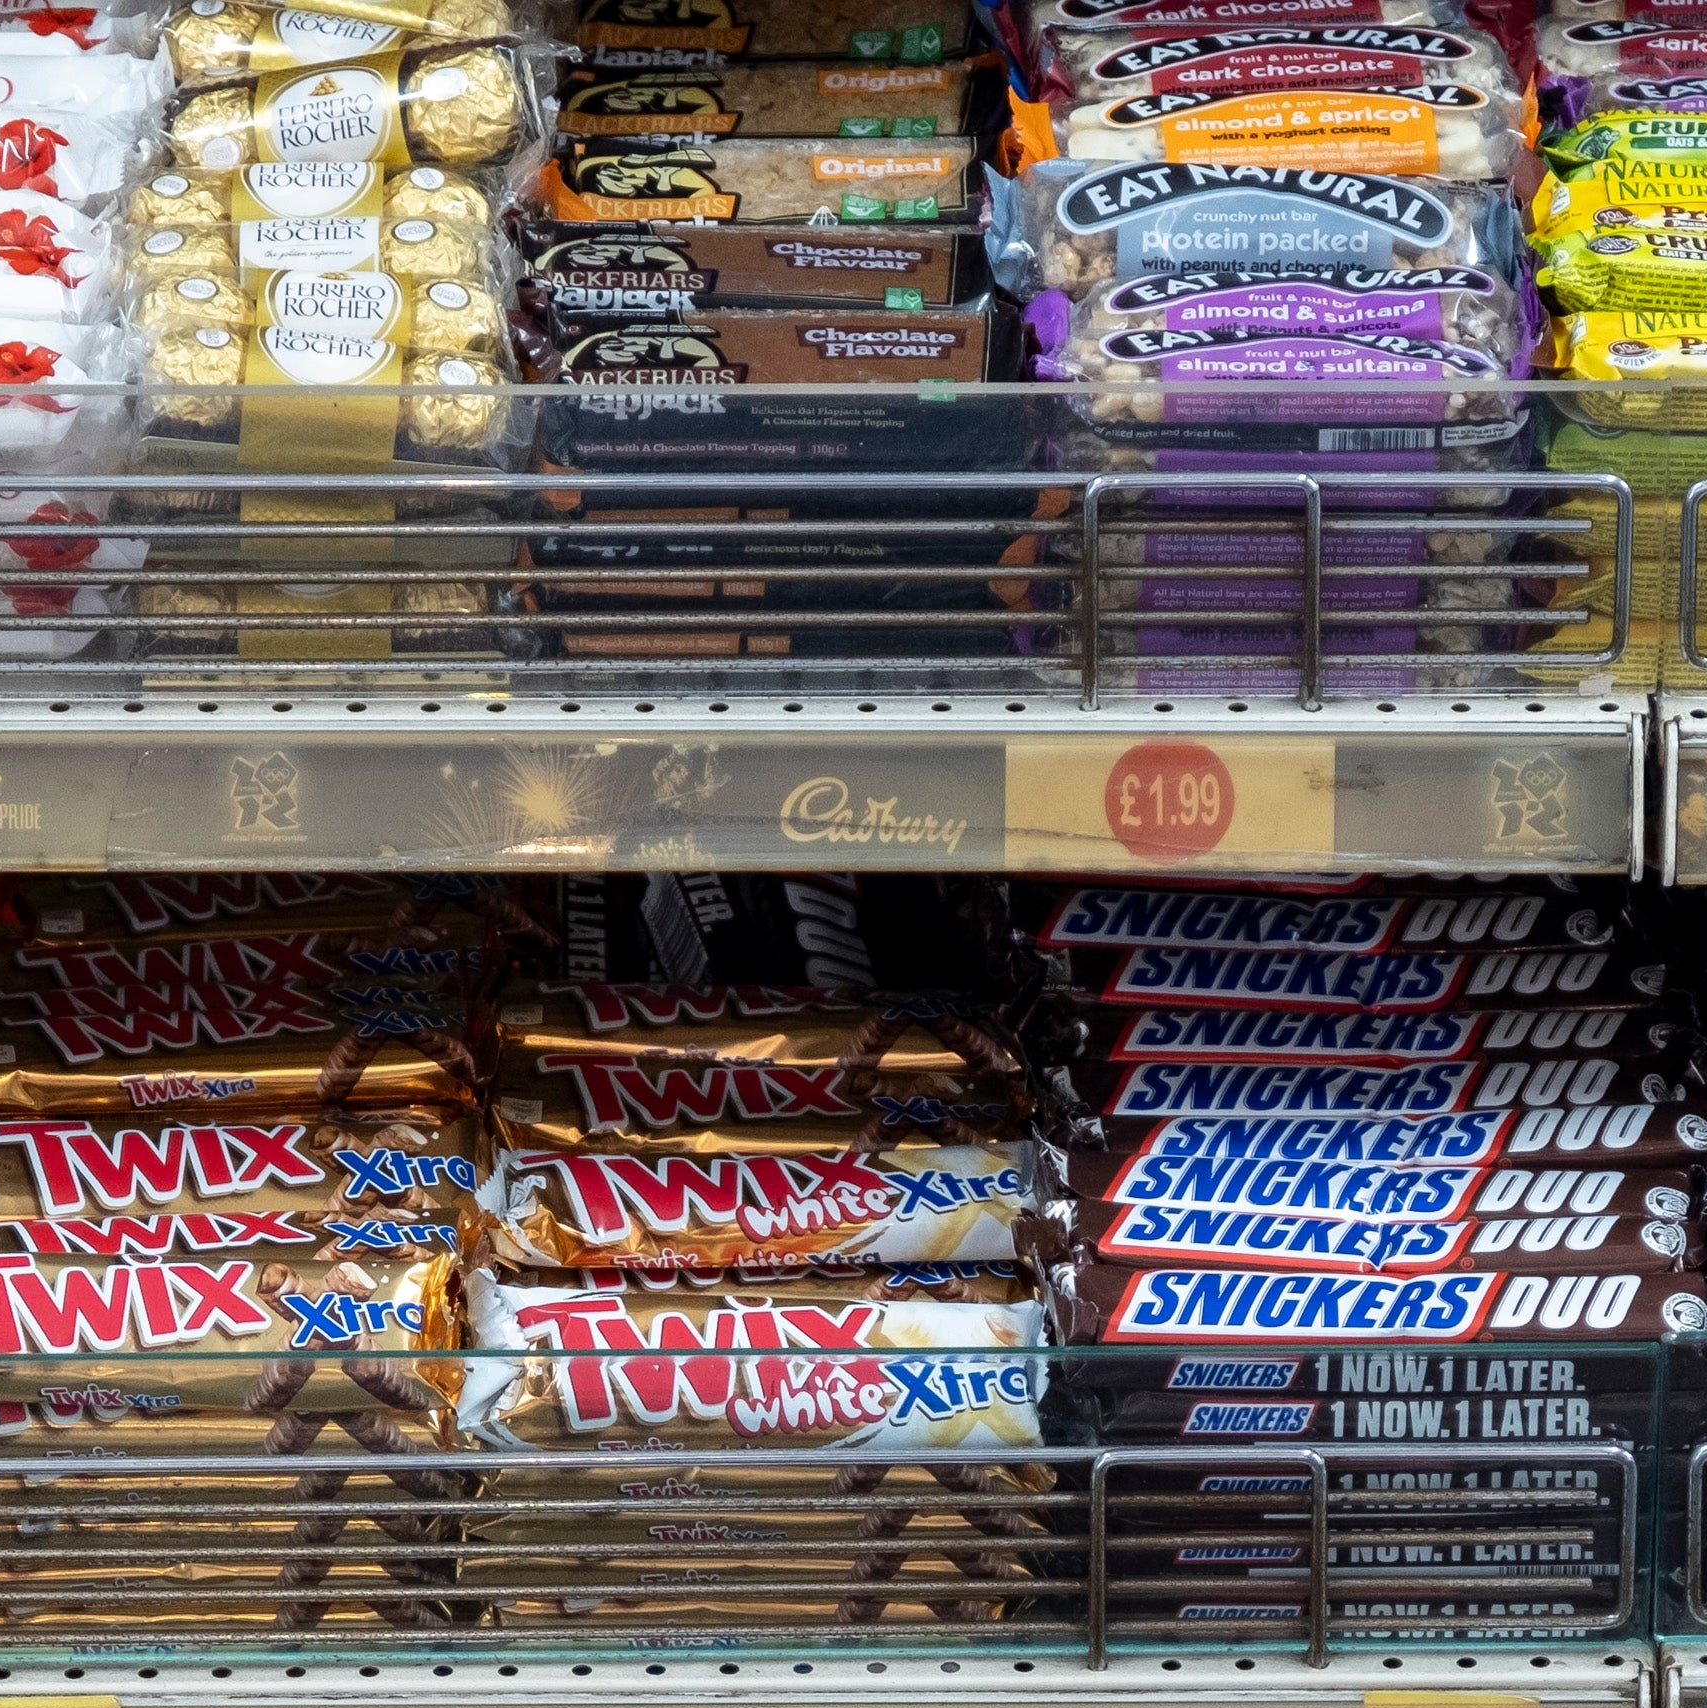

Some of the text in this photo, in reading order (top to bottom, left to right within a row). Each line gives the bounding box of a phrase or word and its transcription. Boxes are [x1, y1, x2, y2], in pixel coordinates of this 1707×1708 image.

[1178, 56, 1394, 82] dark chocolate
[1175, 105, 1421, 133] almond & apricot
[818, 157, 943, 178] Original
[1085, 169, 1172, 219] EAT
[1193, 210, 1318, 225] crunchy nut bar
[773, 243, 922, 262] Chocolate
[1142, 226, 1369, 255] protein packed
[792, 253, 907, 272] Flavour
[284, 283, 386, 303] FERRERO
[283, 298, 384, 321] ROCHER
[1177, 356, 1427, 375] almond & sultana
[1119, 773, 1221, 828] £1.99
[779, 777, 967, 855] Cadbury
[738, 1186, 893, 1242] white
[1133, 1274, 1641, 1328] SNICKERS DUO
[1191, 1399, 1601, 1438] SNICKERS 1 NOW. 1 LATER.
